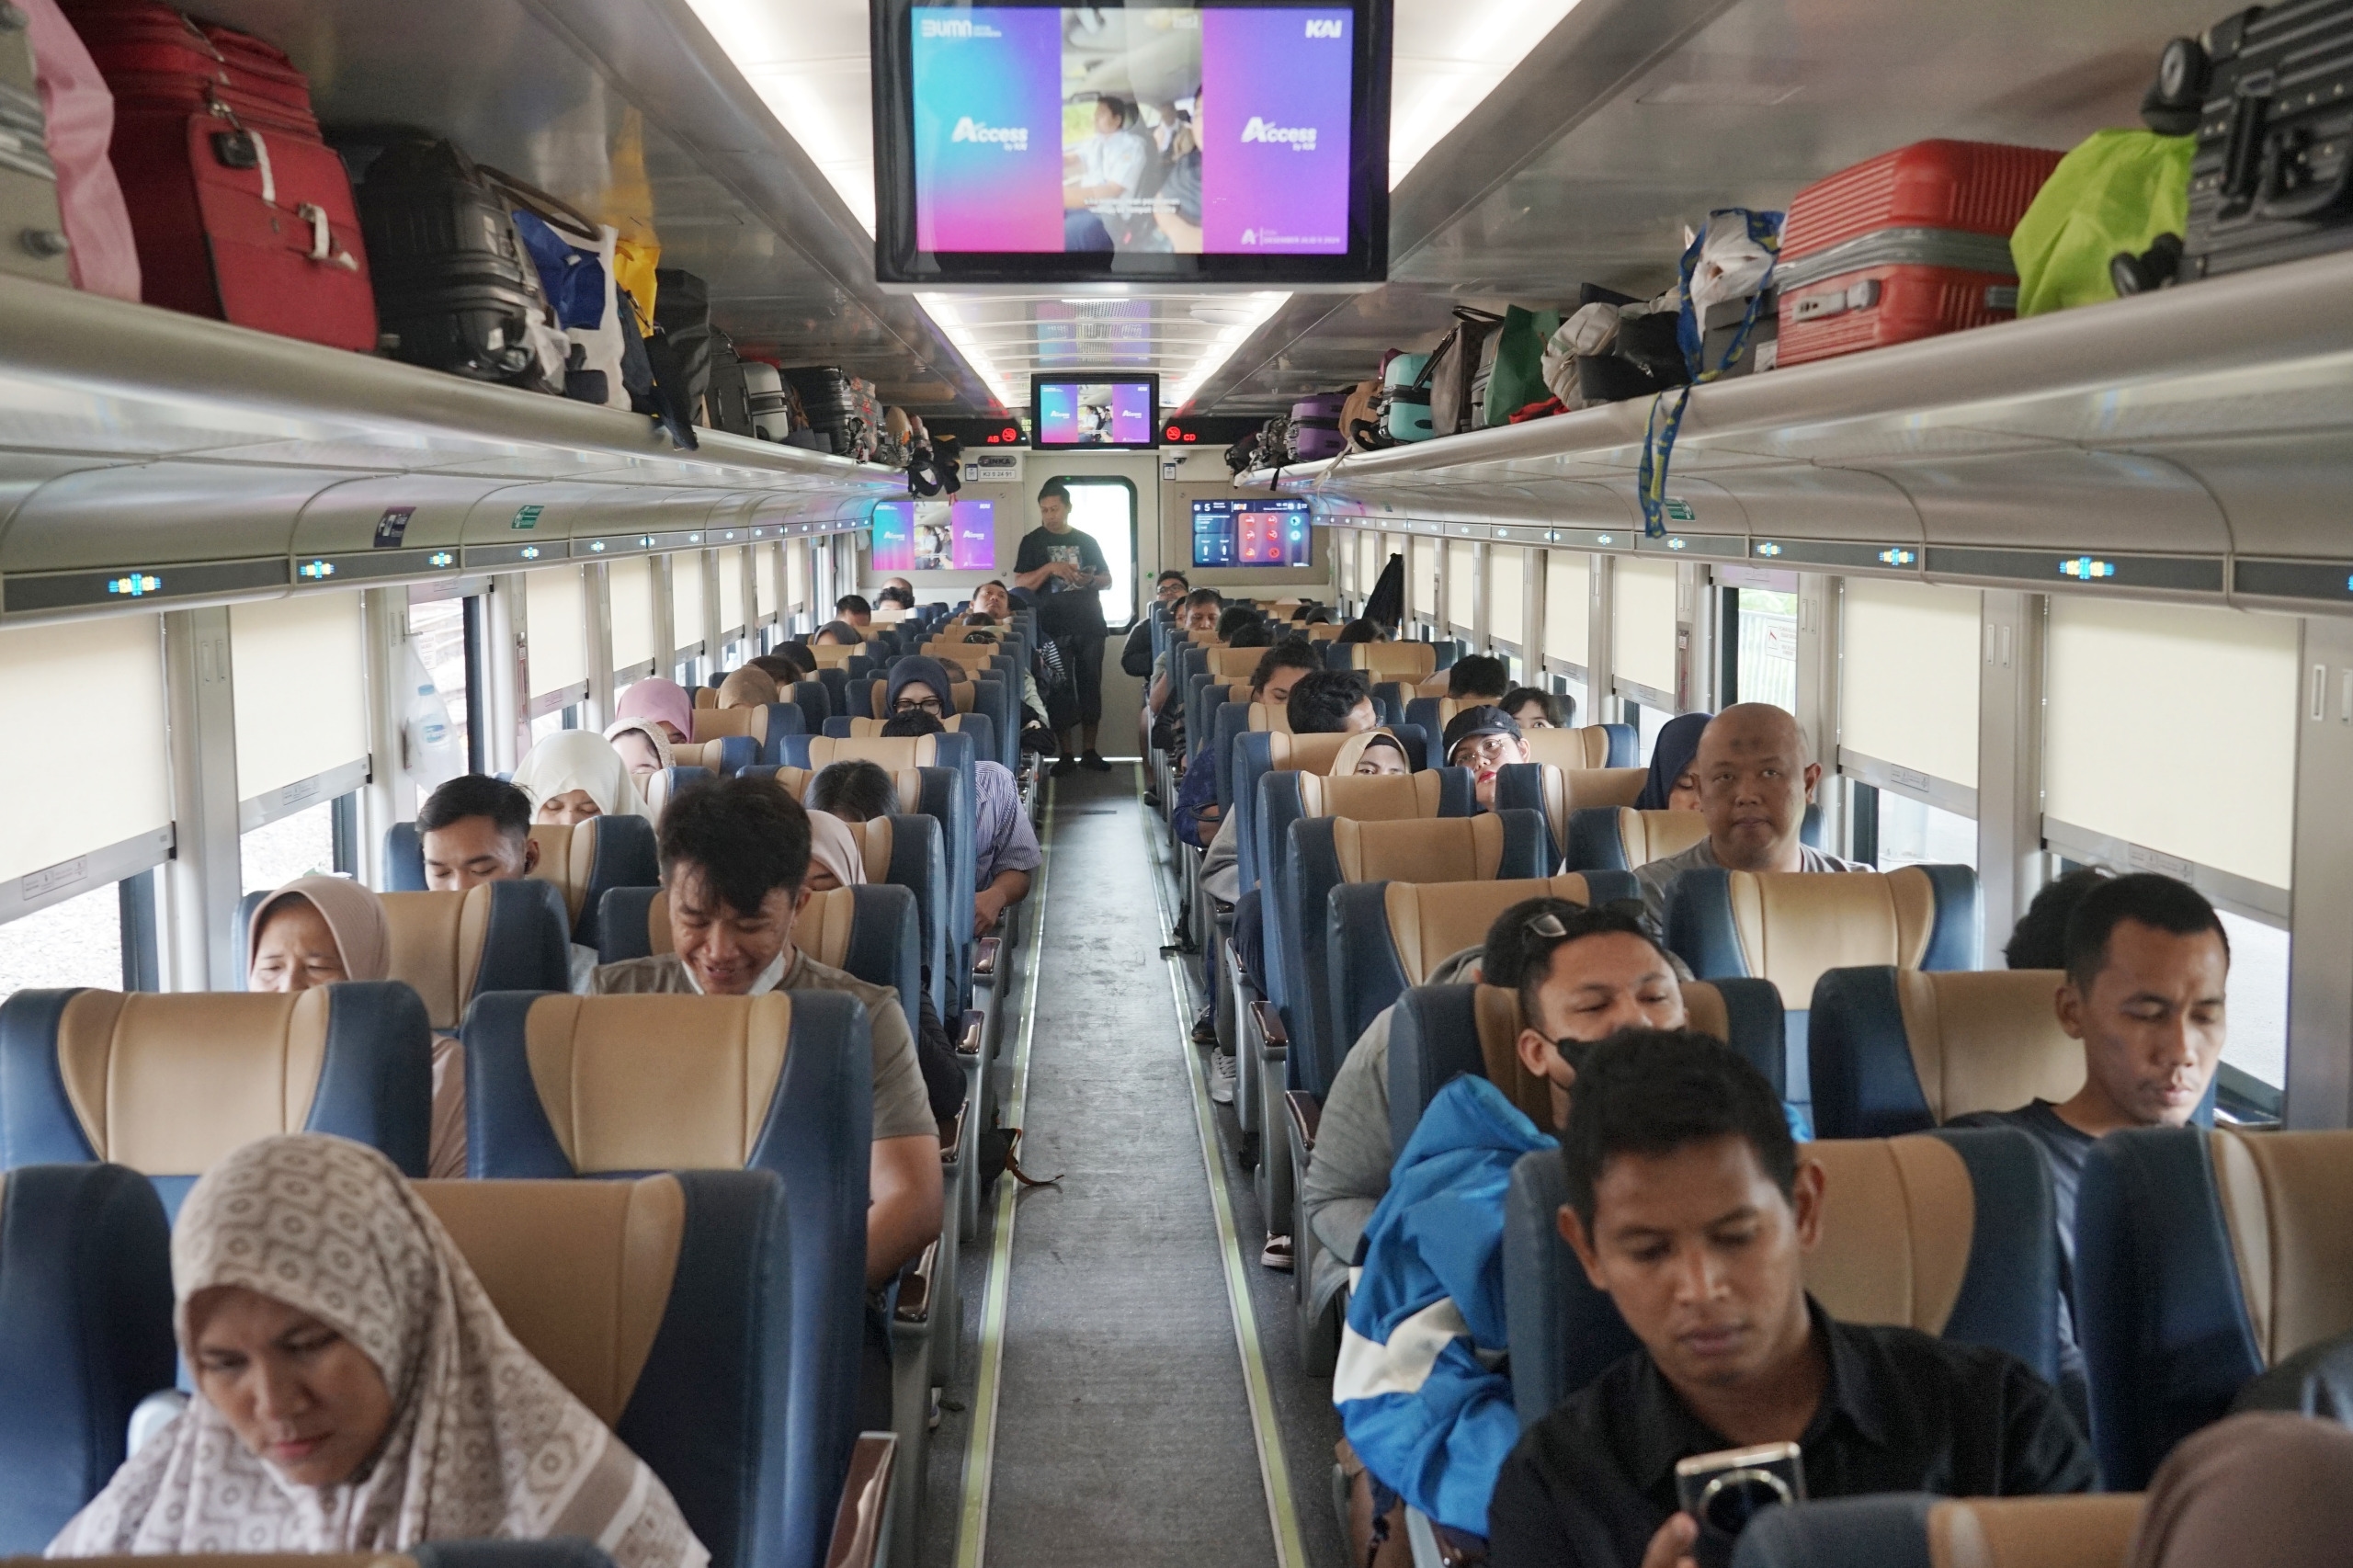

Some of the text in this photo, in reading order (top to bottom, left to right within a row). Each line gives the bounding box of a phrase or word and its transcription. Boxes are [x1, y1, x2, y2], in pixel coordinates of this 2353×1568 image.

[1305, 19, 1343, 39] KAI
[952, 117, 1028, 142] Access
[1241, 117, 1316, 142] Access
[987, 435, 1000, 443] AB
[1183, 433, 1197, 441] CD
[1204, 503, 1211, 512] 5
